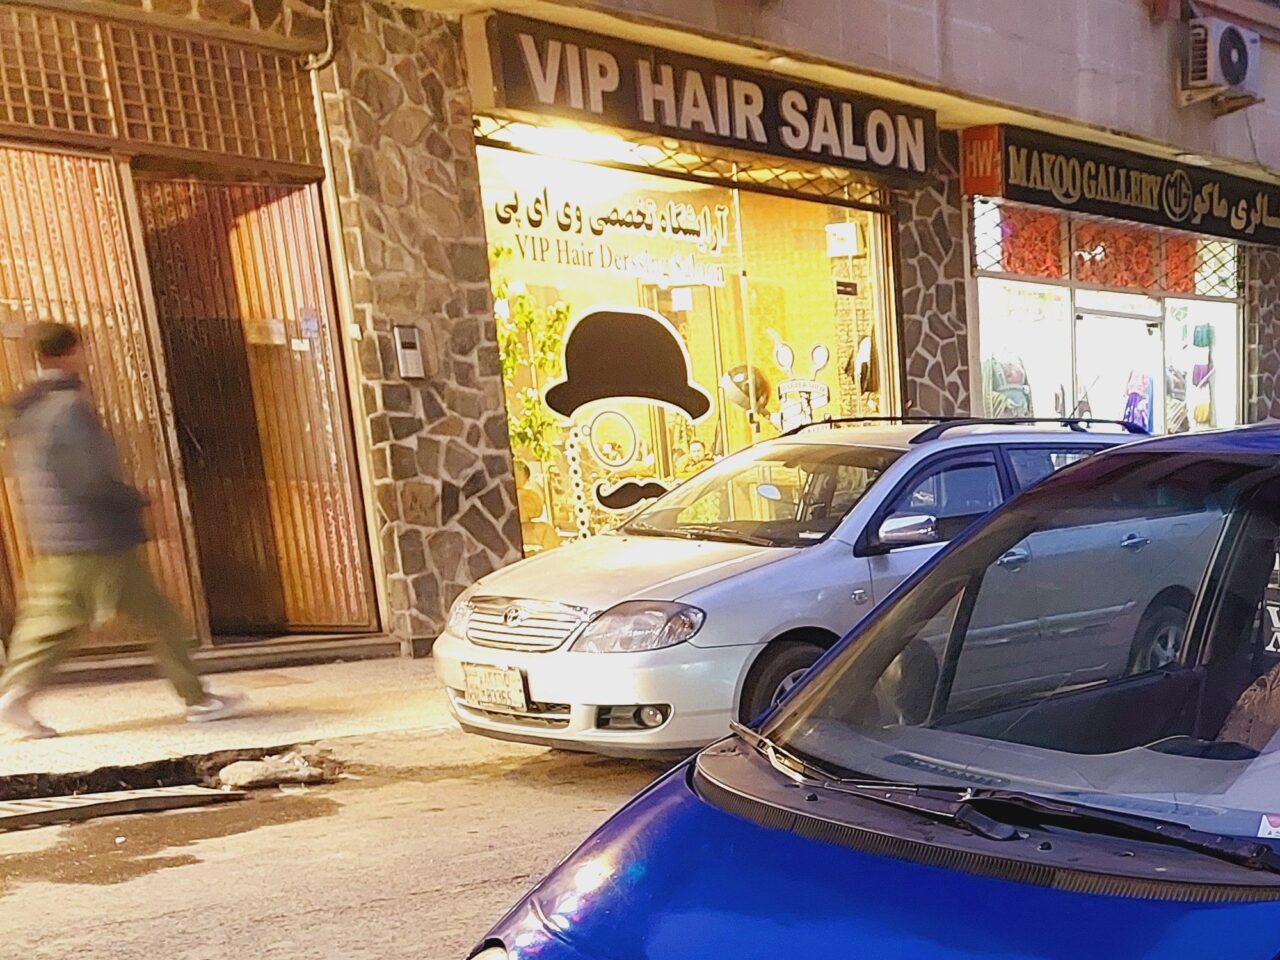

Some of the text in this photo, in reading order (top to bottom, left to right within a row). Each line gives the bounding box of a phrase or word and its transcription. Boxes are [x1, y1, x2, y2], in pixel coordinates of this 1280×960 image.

[519, 33, 928, 173] VIP HAIR SALON
[495, 187, 728, 251] آرایشگاه تخصصی وی ای پی
[1190, 181, 1229, 225] ماکو
[514, 234, 550, 263] VIP
[556, 238, 594, 267] Hair
